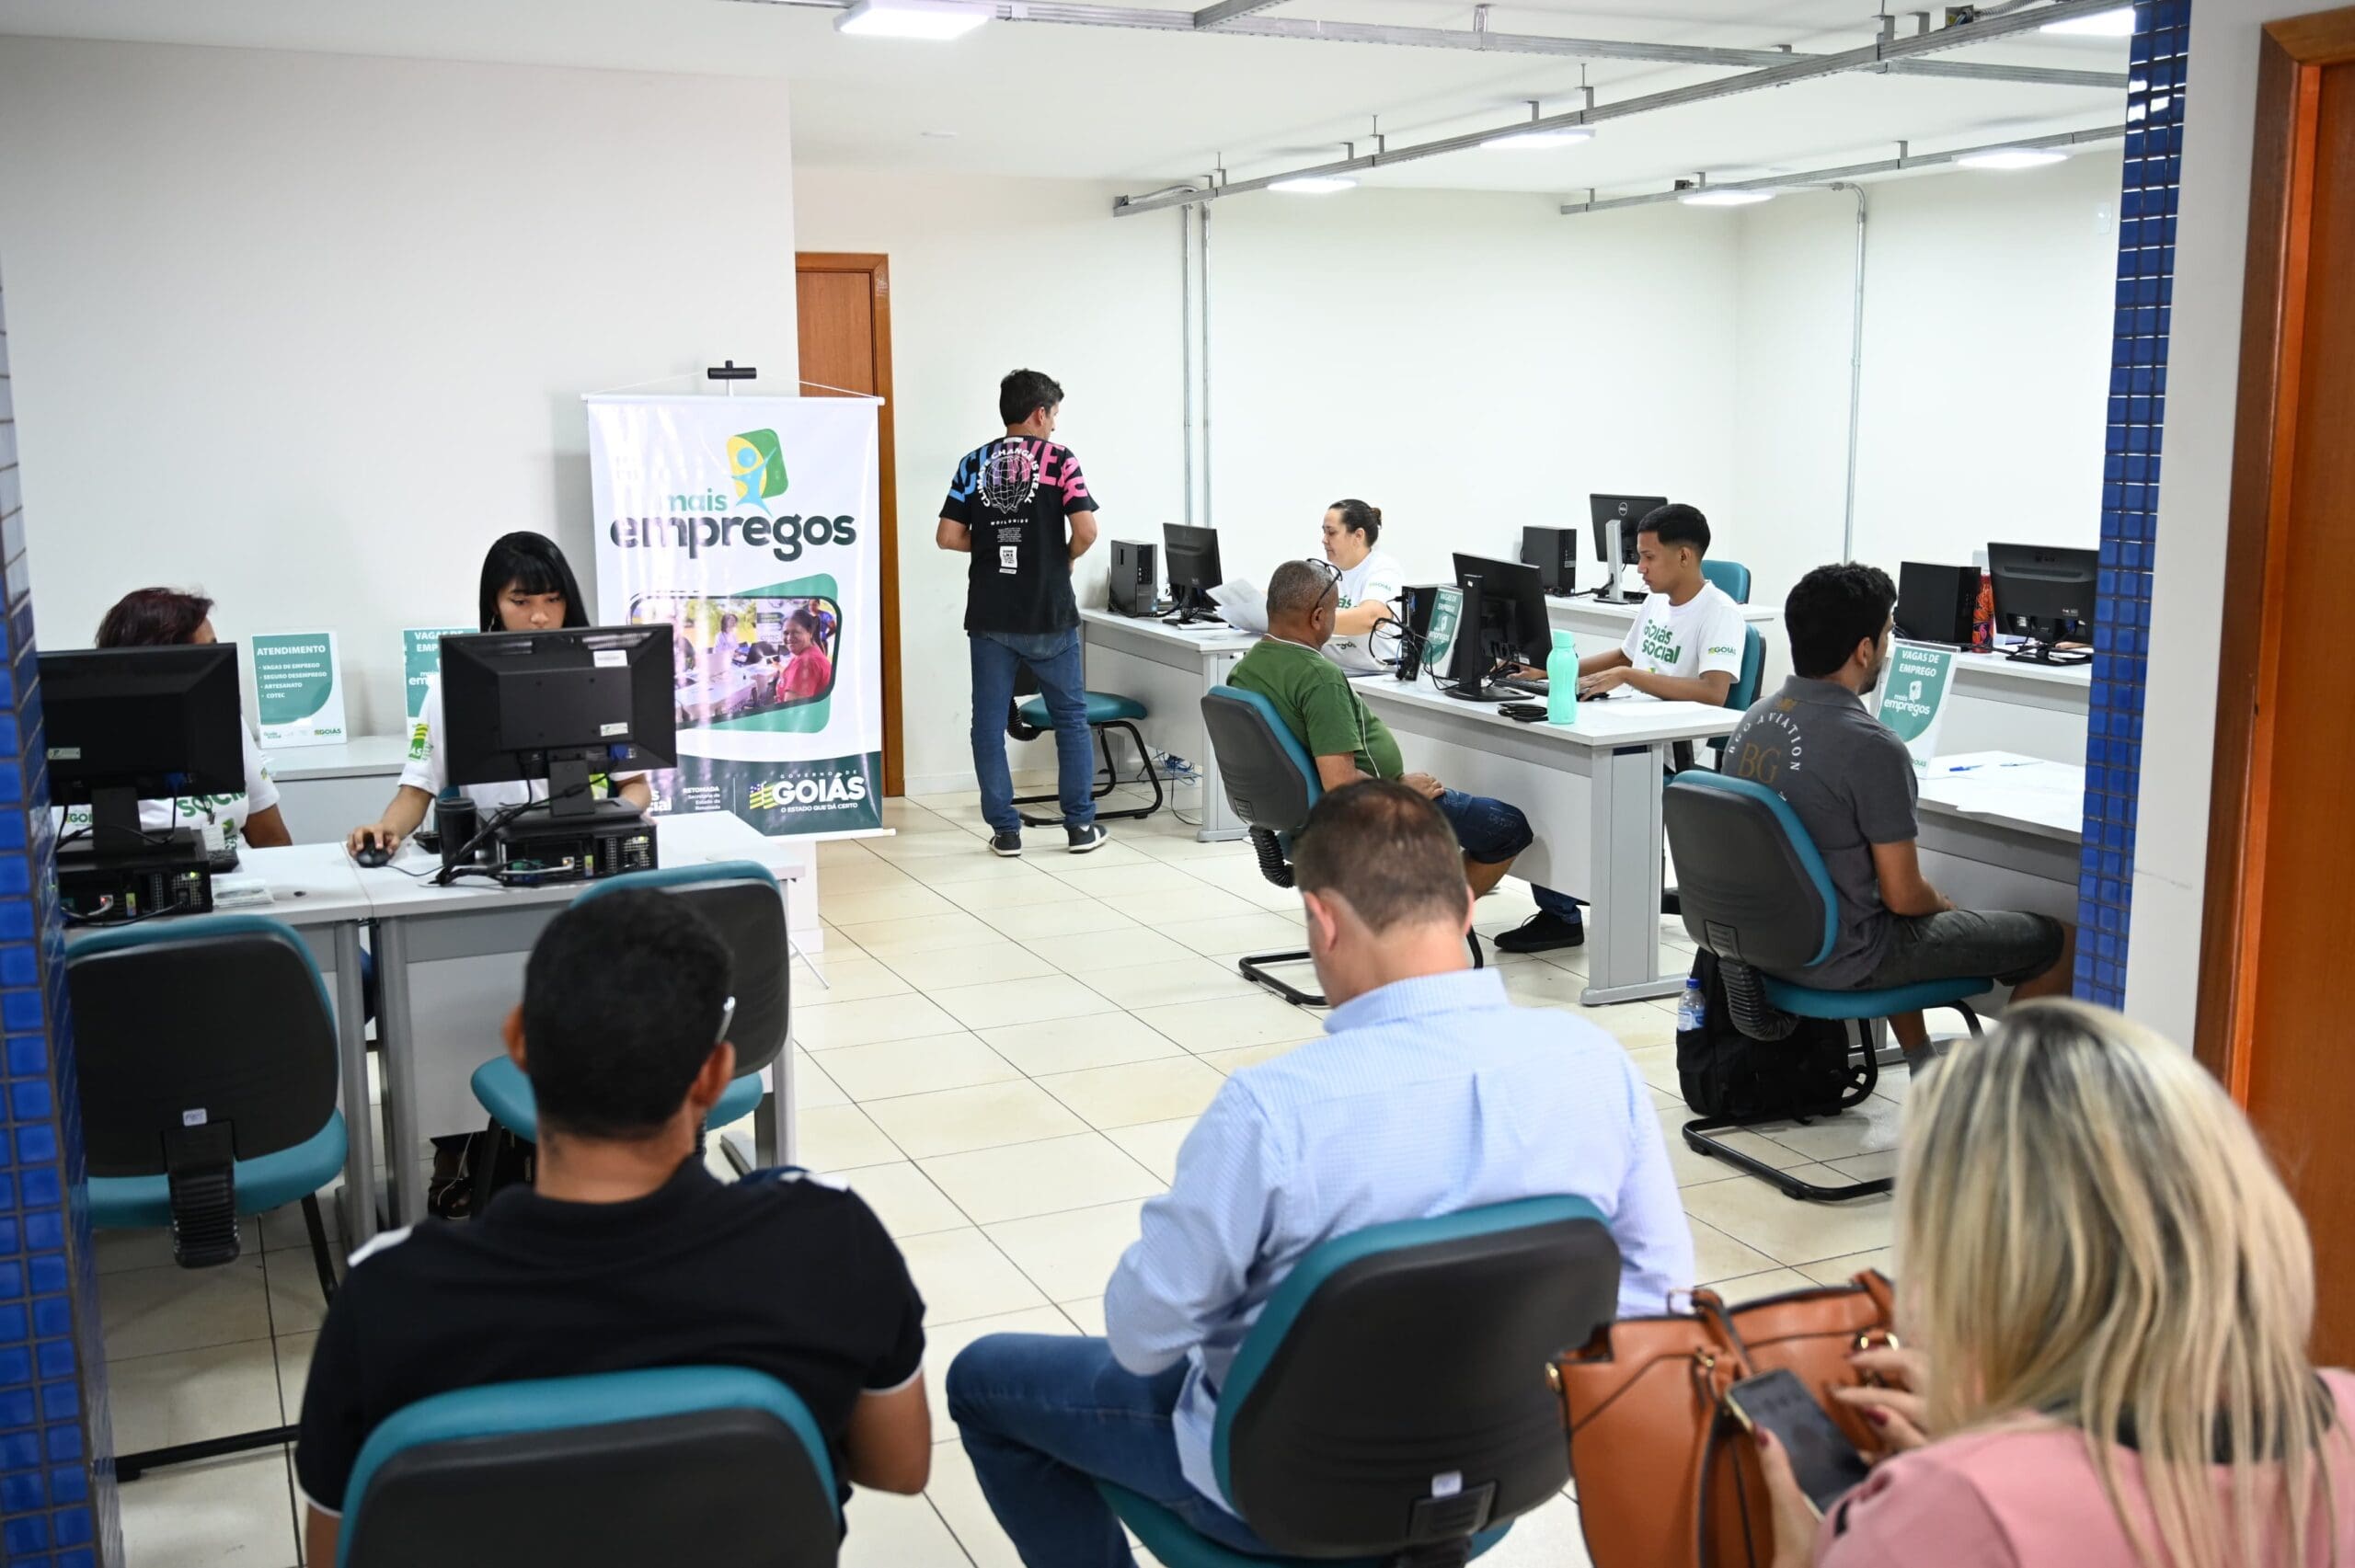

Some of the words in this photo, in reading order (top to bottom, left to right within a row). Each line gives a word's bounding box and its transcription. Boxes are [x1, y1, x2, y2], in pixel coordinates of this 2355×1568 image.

[991, 447, 1035, 462] CHANGE
[1024, 473, 1040, 503] REAL
[610, 513, 856, 562] empregos
[257, 645, 326, 656] ATENDIMENTO
[1642, 639, 1682, 664] social
[1901, 650, 1928, 662] VAGAS
[1928, 654, 1940, 664] DE
[287, 671, 327, 680] DESEMPREGO
[1899, 663, 1936, 677] EMPREGO
[1884, 699, 1930, 717] empregos
[1757, 712, 1802, 771] AVIATION
[1738, 742, 1781, 784] BG
[780, 771, 833, 780] GOVERNO
[683, 785, 720, 794] RETOMADA
[773, 772, 866, 805] GOIÁS
[787, 805, 813, 813] ESTADO
[812, 803, 827, 811] QUE
